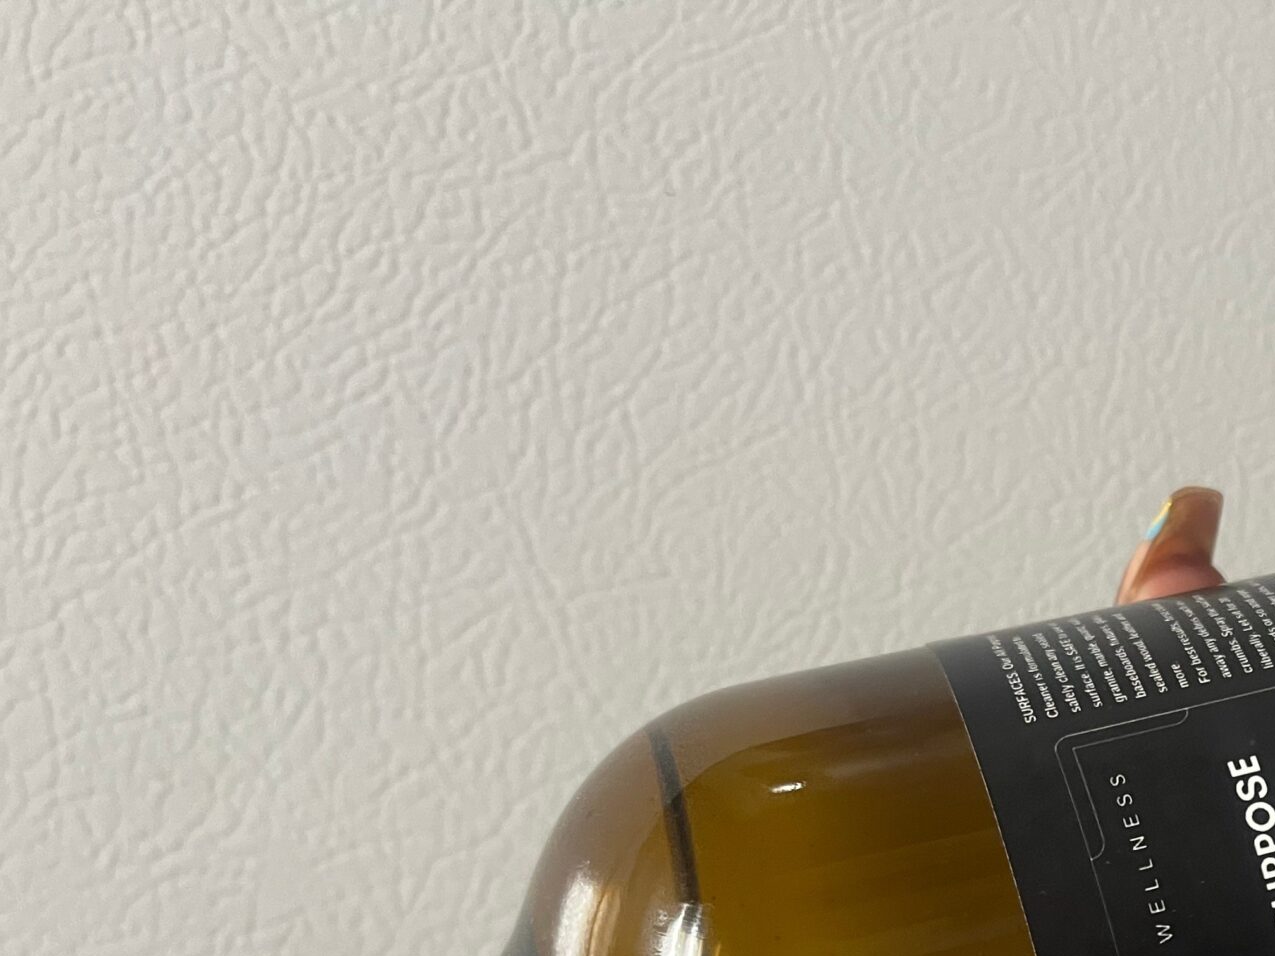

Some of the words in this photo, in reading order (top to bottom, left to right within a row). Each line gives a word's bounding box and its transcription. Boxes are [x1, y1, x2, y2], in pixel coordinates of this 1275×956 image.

[1206, 608, 1220, 618] the
[1226, 602, 1238, 612] for
[1231, 610, 1244, 619] sit
[1255, 608, 1268, 618] so
[1213, 616, 1234, 638] Spray
[1237, 618, 1253, 632] Let
[1261, 618, 1274, 627] or
[1058, 638, 1079, 656] SAFE
[1204, 638, 1219, 653] any
[1013, 640, 1039, 673] formulated
[1044, 649, 1058, 661] any
[1072, 655, 1083, 664] is
[1184, 645, 1202, 666] best
[1051, 661, 1069, 683] clean
[1115, 645, 1147, 699] baseboards,
[1213, 654, 1233, 679] away
[1032, 672, 1044, 681] is
[1195, 667, 1212, 684] For
[1103, 667, 1128, 703] granite,
[1036, 682, 1059, 719] Cleaner
[1061, 684, 1082, 713] safely
[1109, 774, 1172, 943] WELLNESS
